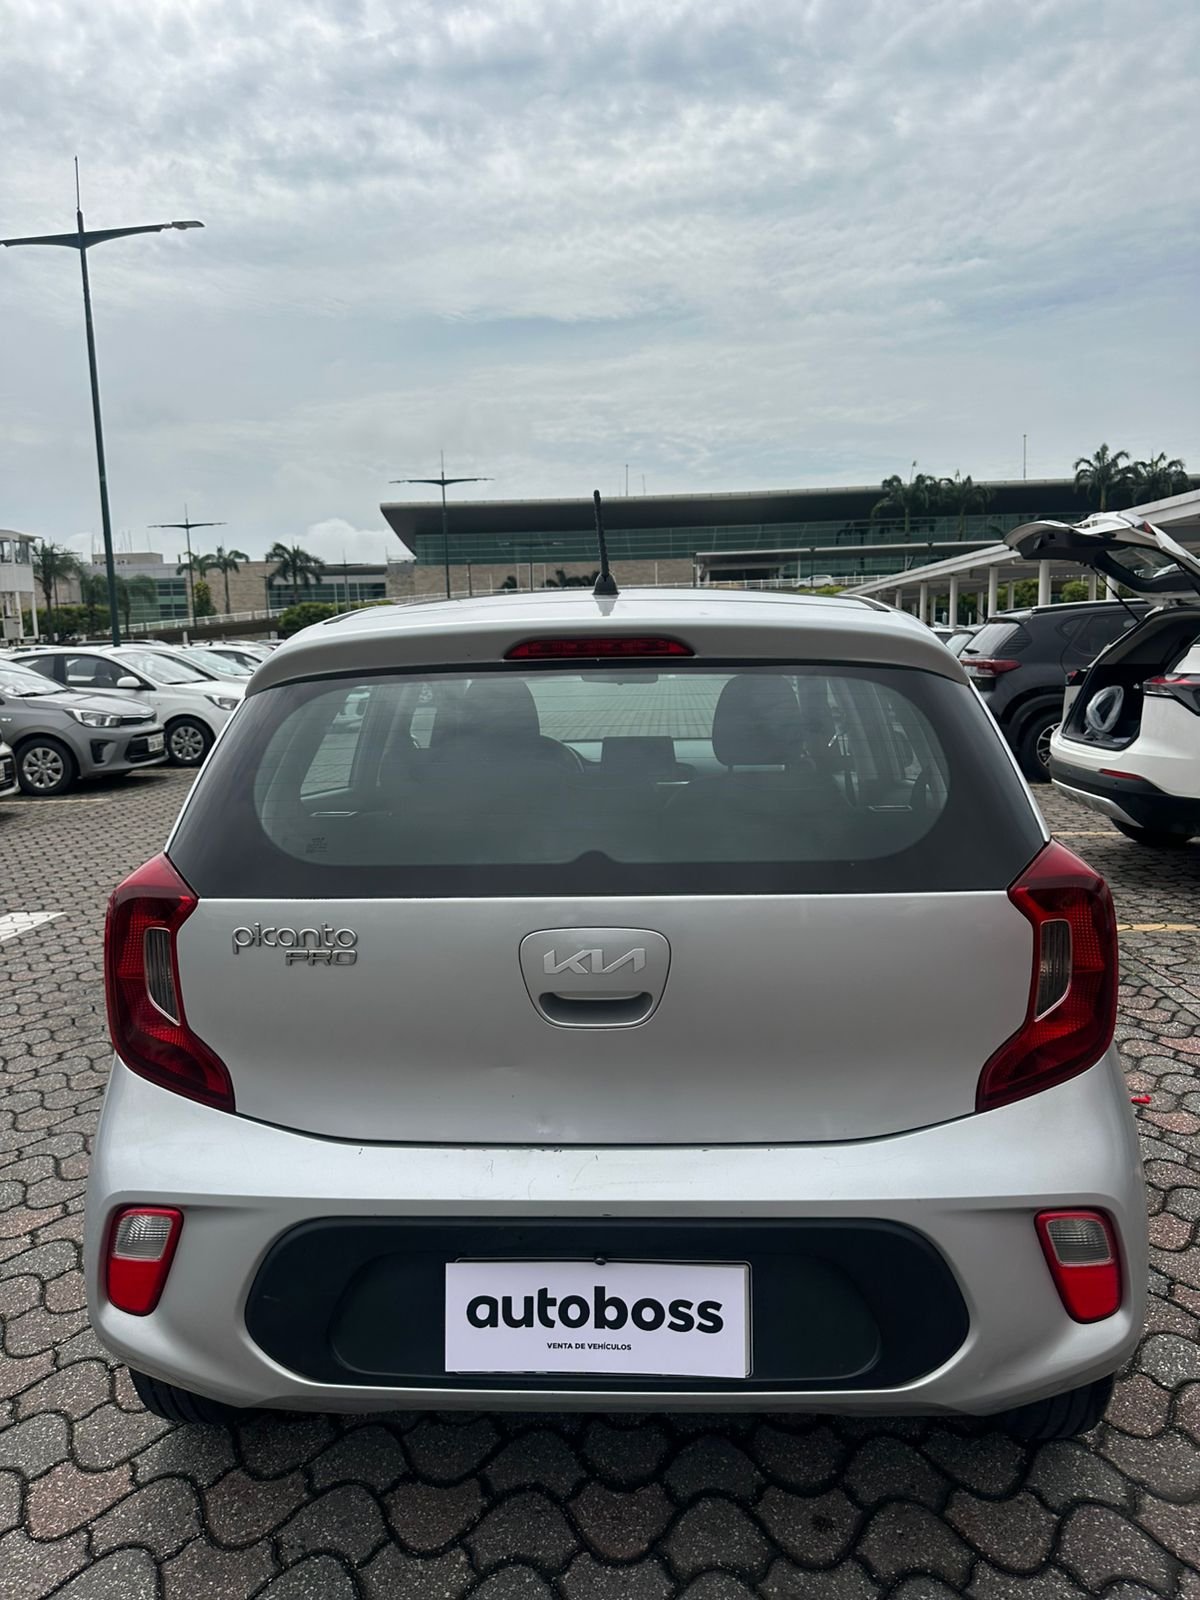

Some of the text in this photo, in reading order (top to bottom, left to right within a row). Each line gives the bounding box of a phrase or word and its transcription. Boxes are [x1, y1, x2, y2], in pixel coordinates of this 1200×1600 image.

[232, 921, 358, 955] picanto
[285, 949, 358, 966] PRO
[543, 948, 646, 974] KIA
[466, 1285, 724, 1334] autoboss
[547, 1341, 632, 1351] VENTA DE VEHÍCULOS
